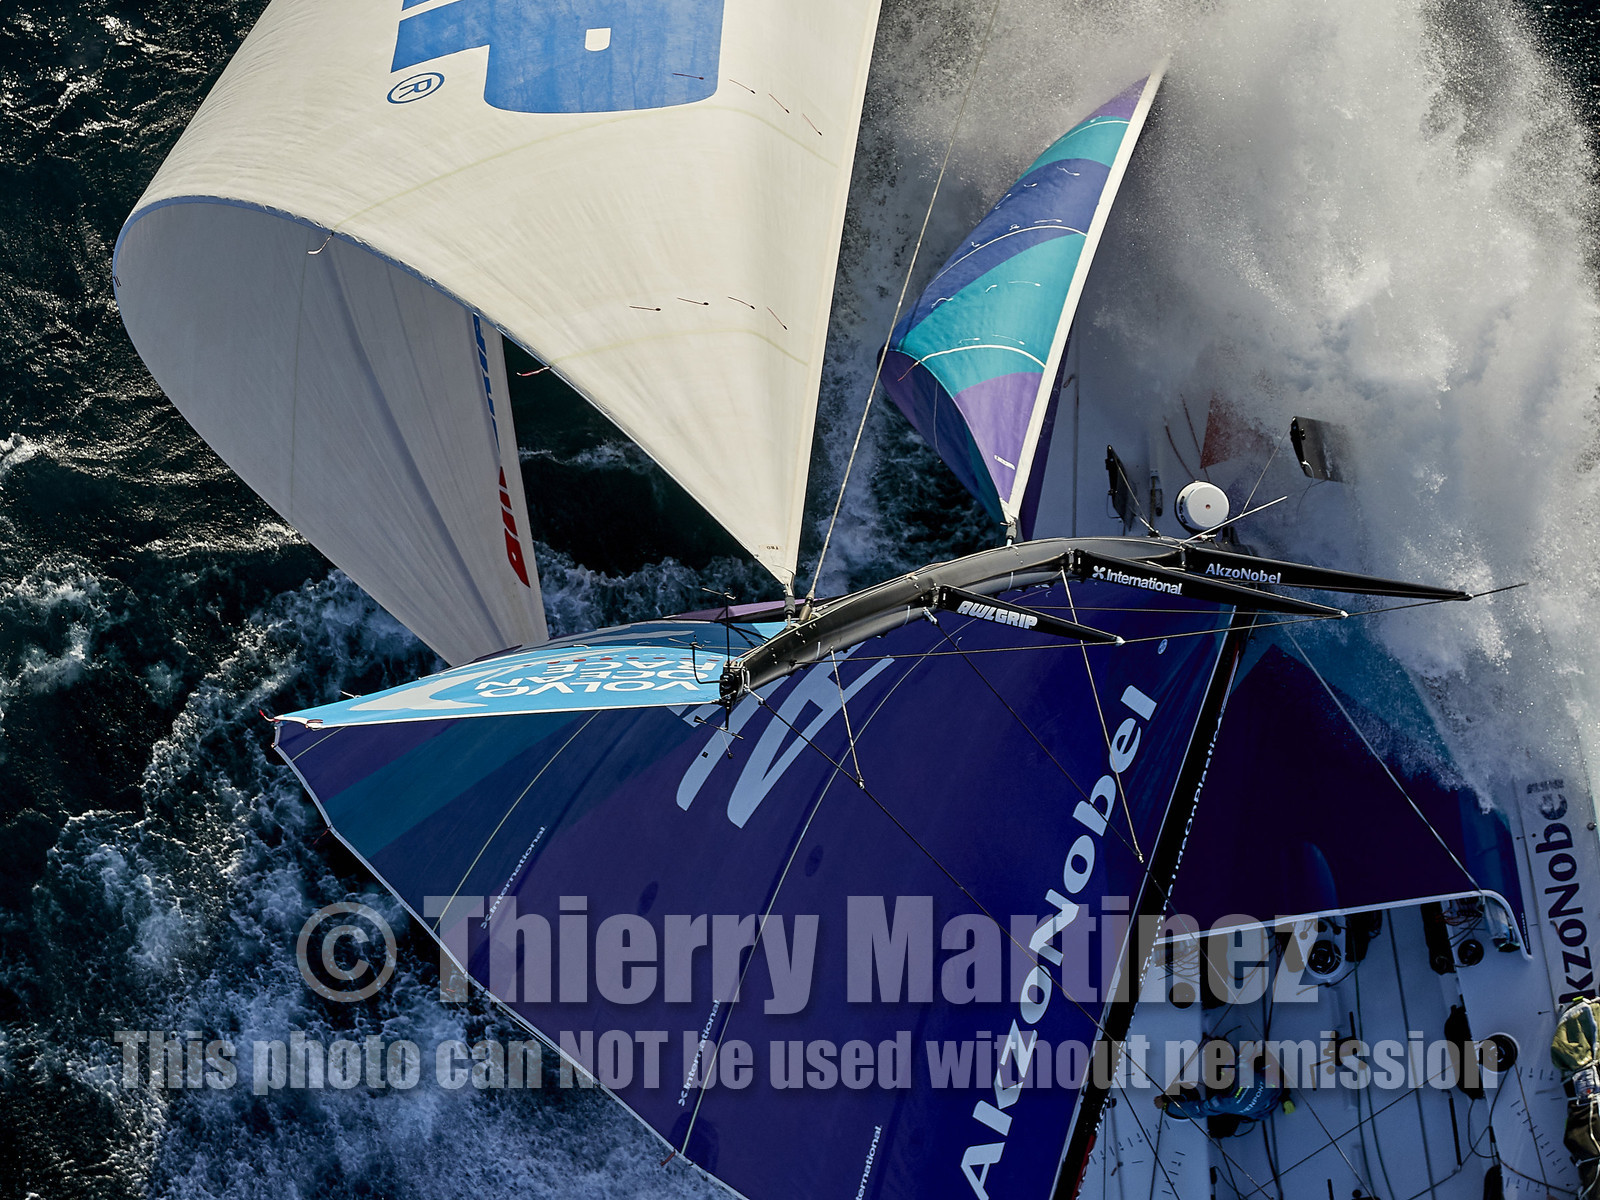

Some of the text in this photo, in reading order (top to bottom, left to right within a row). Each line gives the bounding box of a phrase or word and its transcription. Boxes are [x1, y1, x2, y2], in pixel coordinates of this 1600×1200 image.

[1205, 563, 1281, 584] AkzoNobel
[956, 600, 1038, 629] AWLGRIP
[474, 669, 709, 691] OCEAN
[541, 660, 717, 676] RACE
[478, 680, 700, 698] VOLVO
[1526, 778, 1596, 1004] kzoNobel
[960, 685, 1157, 1200] AkzoNobel
[855, 1125, 882, 1200] ternational
